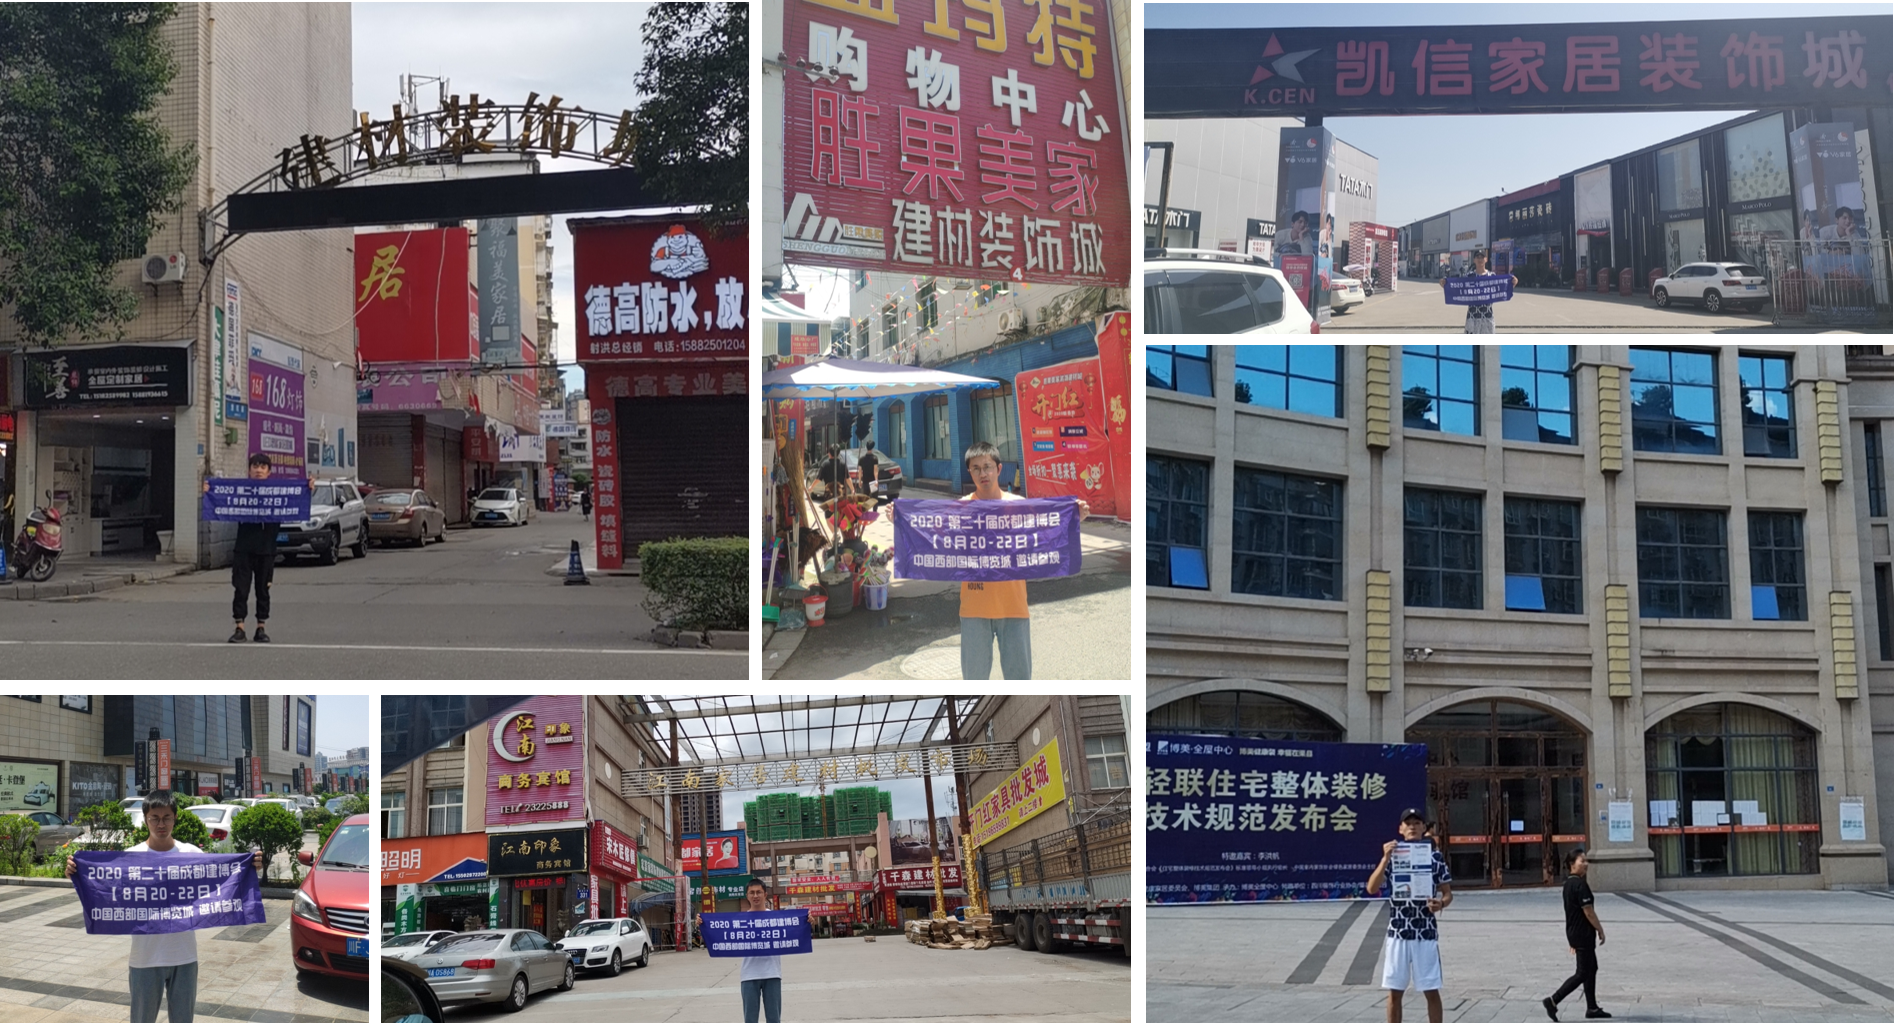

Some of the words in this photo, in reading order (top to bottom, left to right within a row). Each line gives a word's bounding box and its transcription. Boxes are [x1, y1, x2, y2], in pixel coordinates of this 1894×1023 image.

[793, 0, 1098, 79] 玛特
[1335, 29, 1868, 98] 凯信家居装饰城
[806, 21, 1111, 142] 购物中心
[1244, 87, 1316, 105] K.CEN
[810, 88, 1099, 217] 胜果美家
[1339, 173, 1373, 200] TATA木门
[358, 244, 407, 302] 居
[1032, 386, 1080, 421] 开门红
[214, 486, 235, 495] 2020
[910, 514, 943, 529] 2020
[948, 511, 1061, 530] 第二十届成都建博会
[913, 553, 1012, 569] 中国西部国际博览城
[1016, 550, 1061, 568] 邀请参观
[516, 715, 535, 756] 江南
[498, 769, 571, 790] 商务宾馆
[1146, 767, 1388, 800] 轻联住宅整体装修
[524, 800, 569, 813] 23225888
[1146, 802, 1359, 833] 技术规范发布会
[500, 837, 562, 858] 江南印象
[88, 866, 122, 880] 2020
[128, 862, 242, 881] 第二十届成都建博会
[91, 904, 194, 922] 中国西部国际博览城
[199, 898, 244, 916] 邀请参观
[710, 920, 730, 929] 2020
